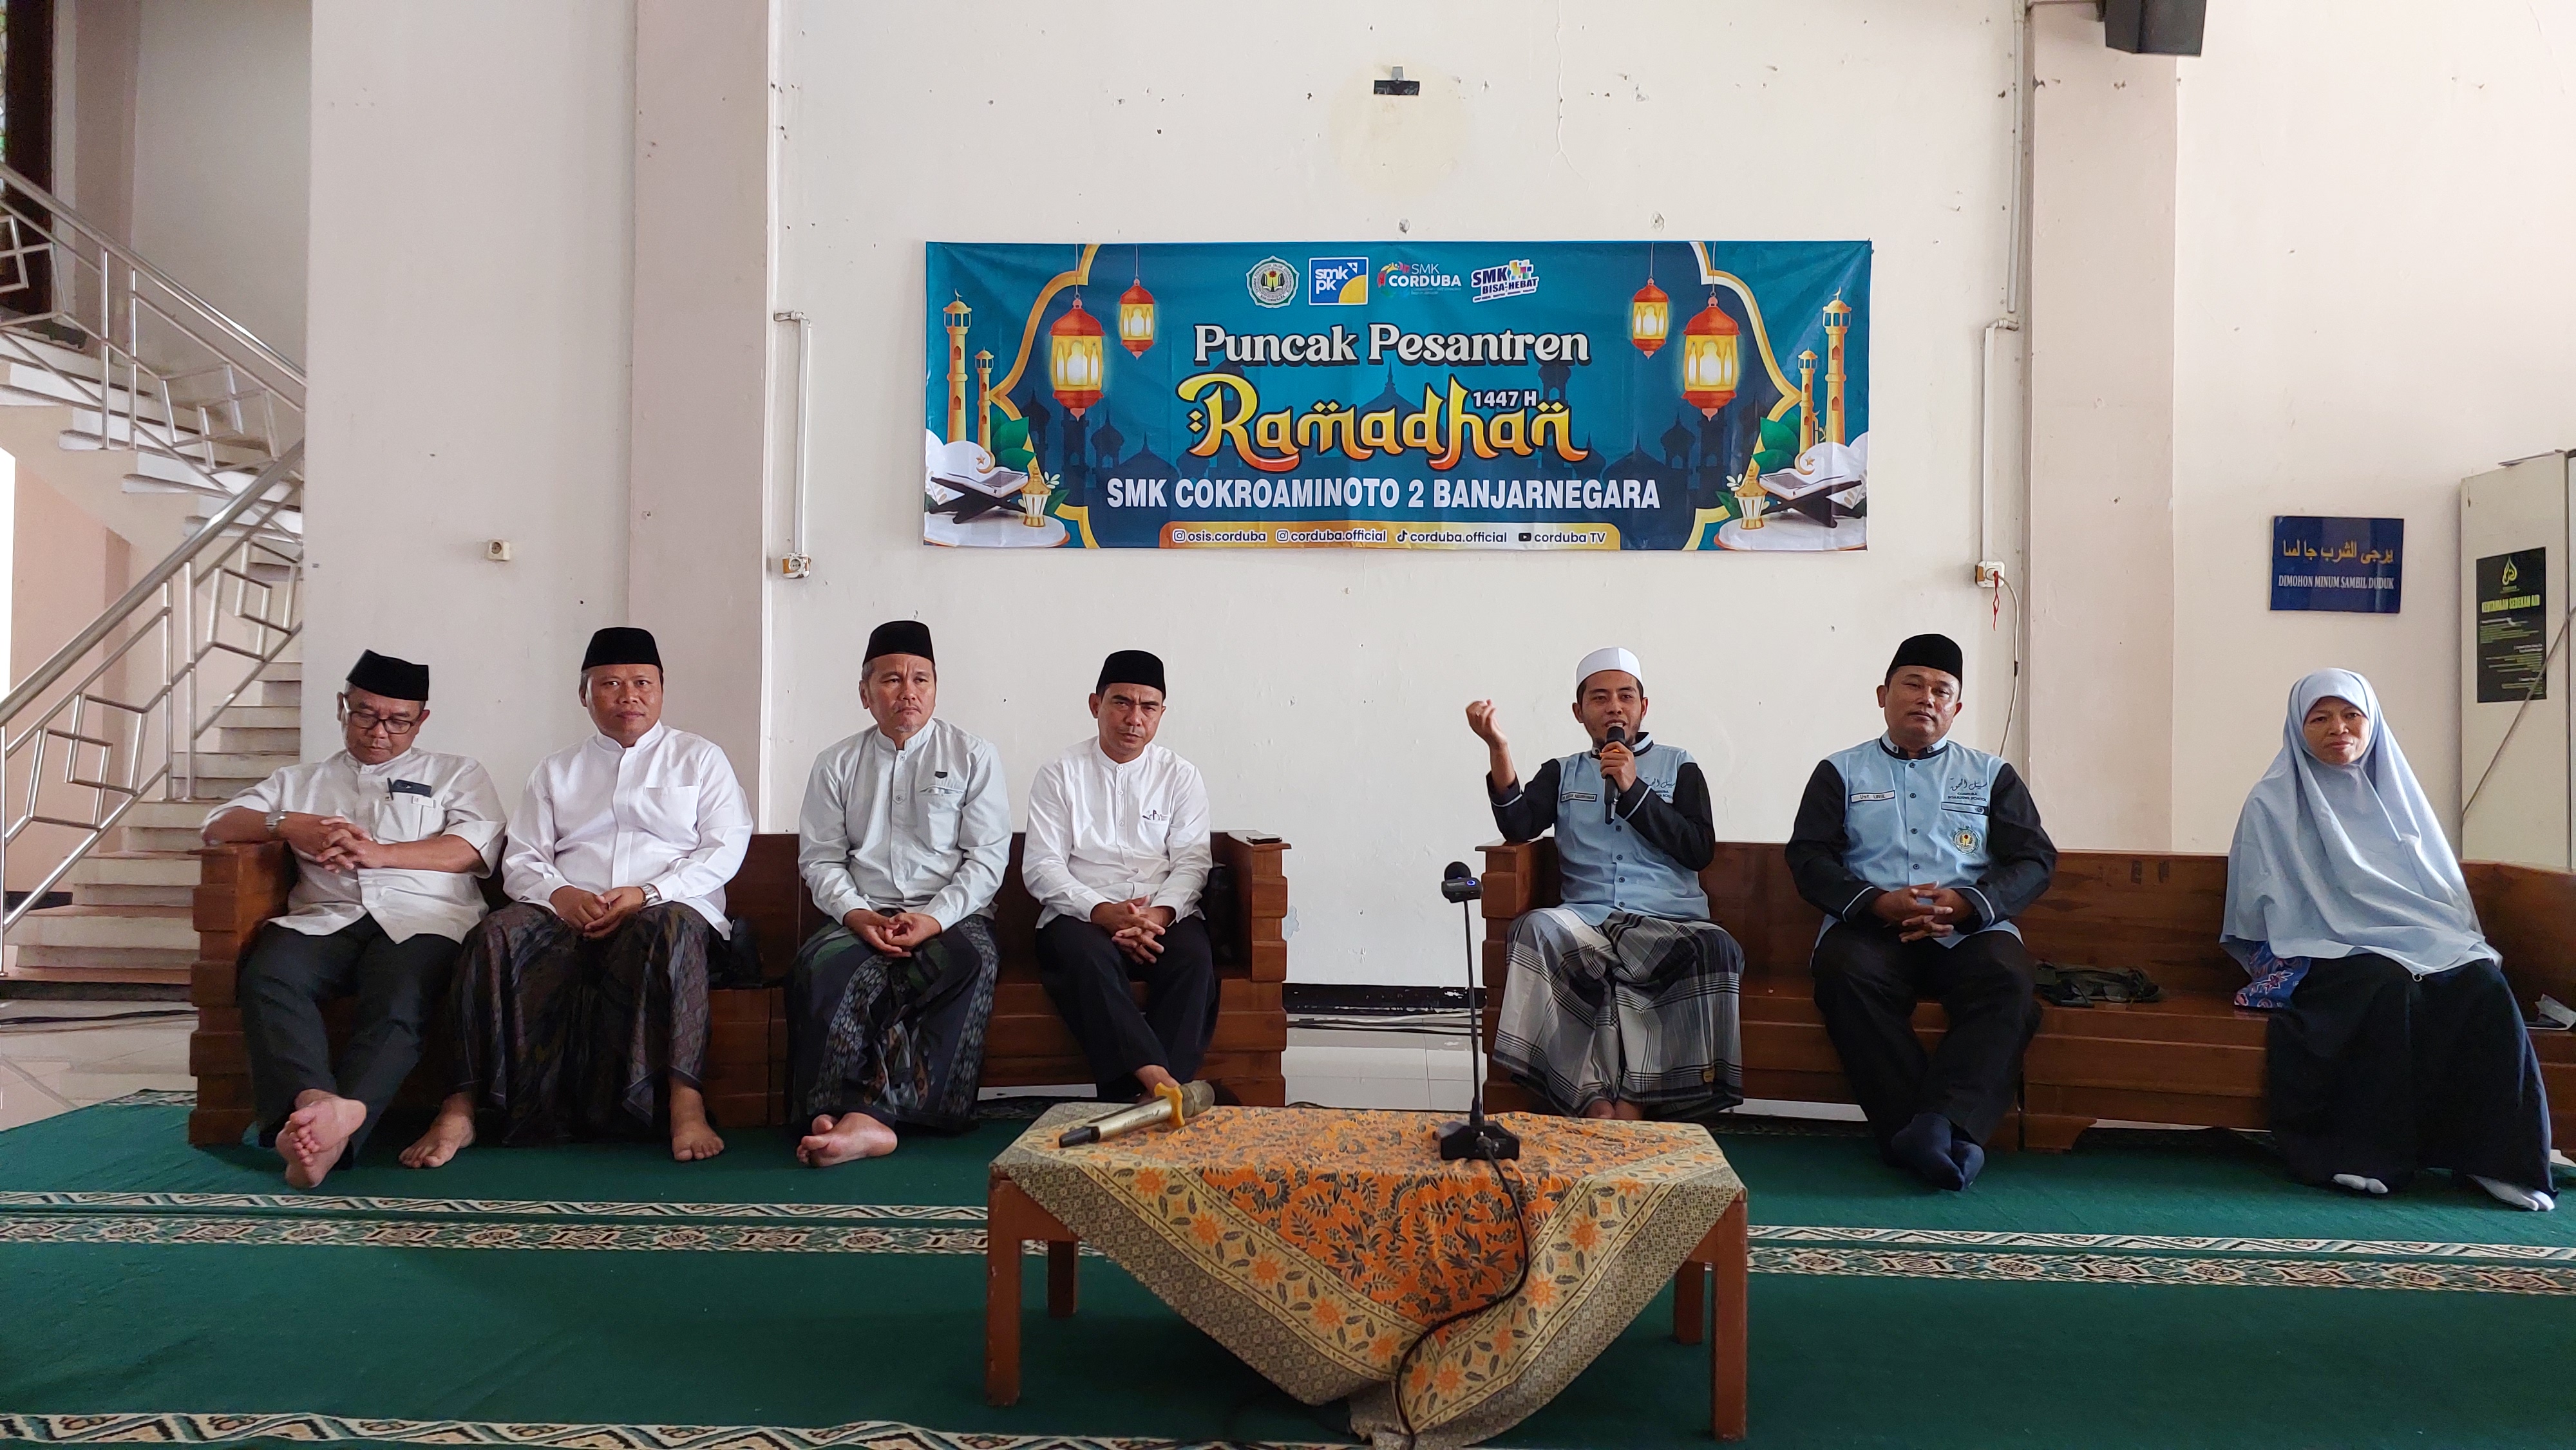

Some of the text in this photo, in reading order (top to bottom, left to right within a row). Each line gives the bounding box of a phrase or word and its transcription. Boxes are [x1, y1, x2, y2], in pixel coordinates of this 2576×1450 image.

[1314, 265, 1349, 280] smk
[1411, 263, 1440, 274] SMK
[1388, 274, 1462, 287] CORDUBA
[1472, 267, 1508, 286] SMK
[1316, 278, 1337, 294] pk
[1193, 323, 1591, 363] Puncak Pesantren
[1472, 390, 1537, 408] 1447 H
[1178, 373, 1589, 472] Ramadhan
[1106, 477, 1661, 509] SMK COKROAMINOTO 2 BANJARNEGARA
[1187, 531, 1267, 542] osis.corduba
[1290, 530, 1387, 543] corduba.official
[1409, 531, 1507, 543] corduba.official
[1533, 532, 1606, 543] corduba TV
[2278, 574, 2394, 590] DIMOHON MINUM SAMBIL DUDUK
